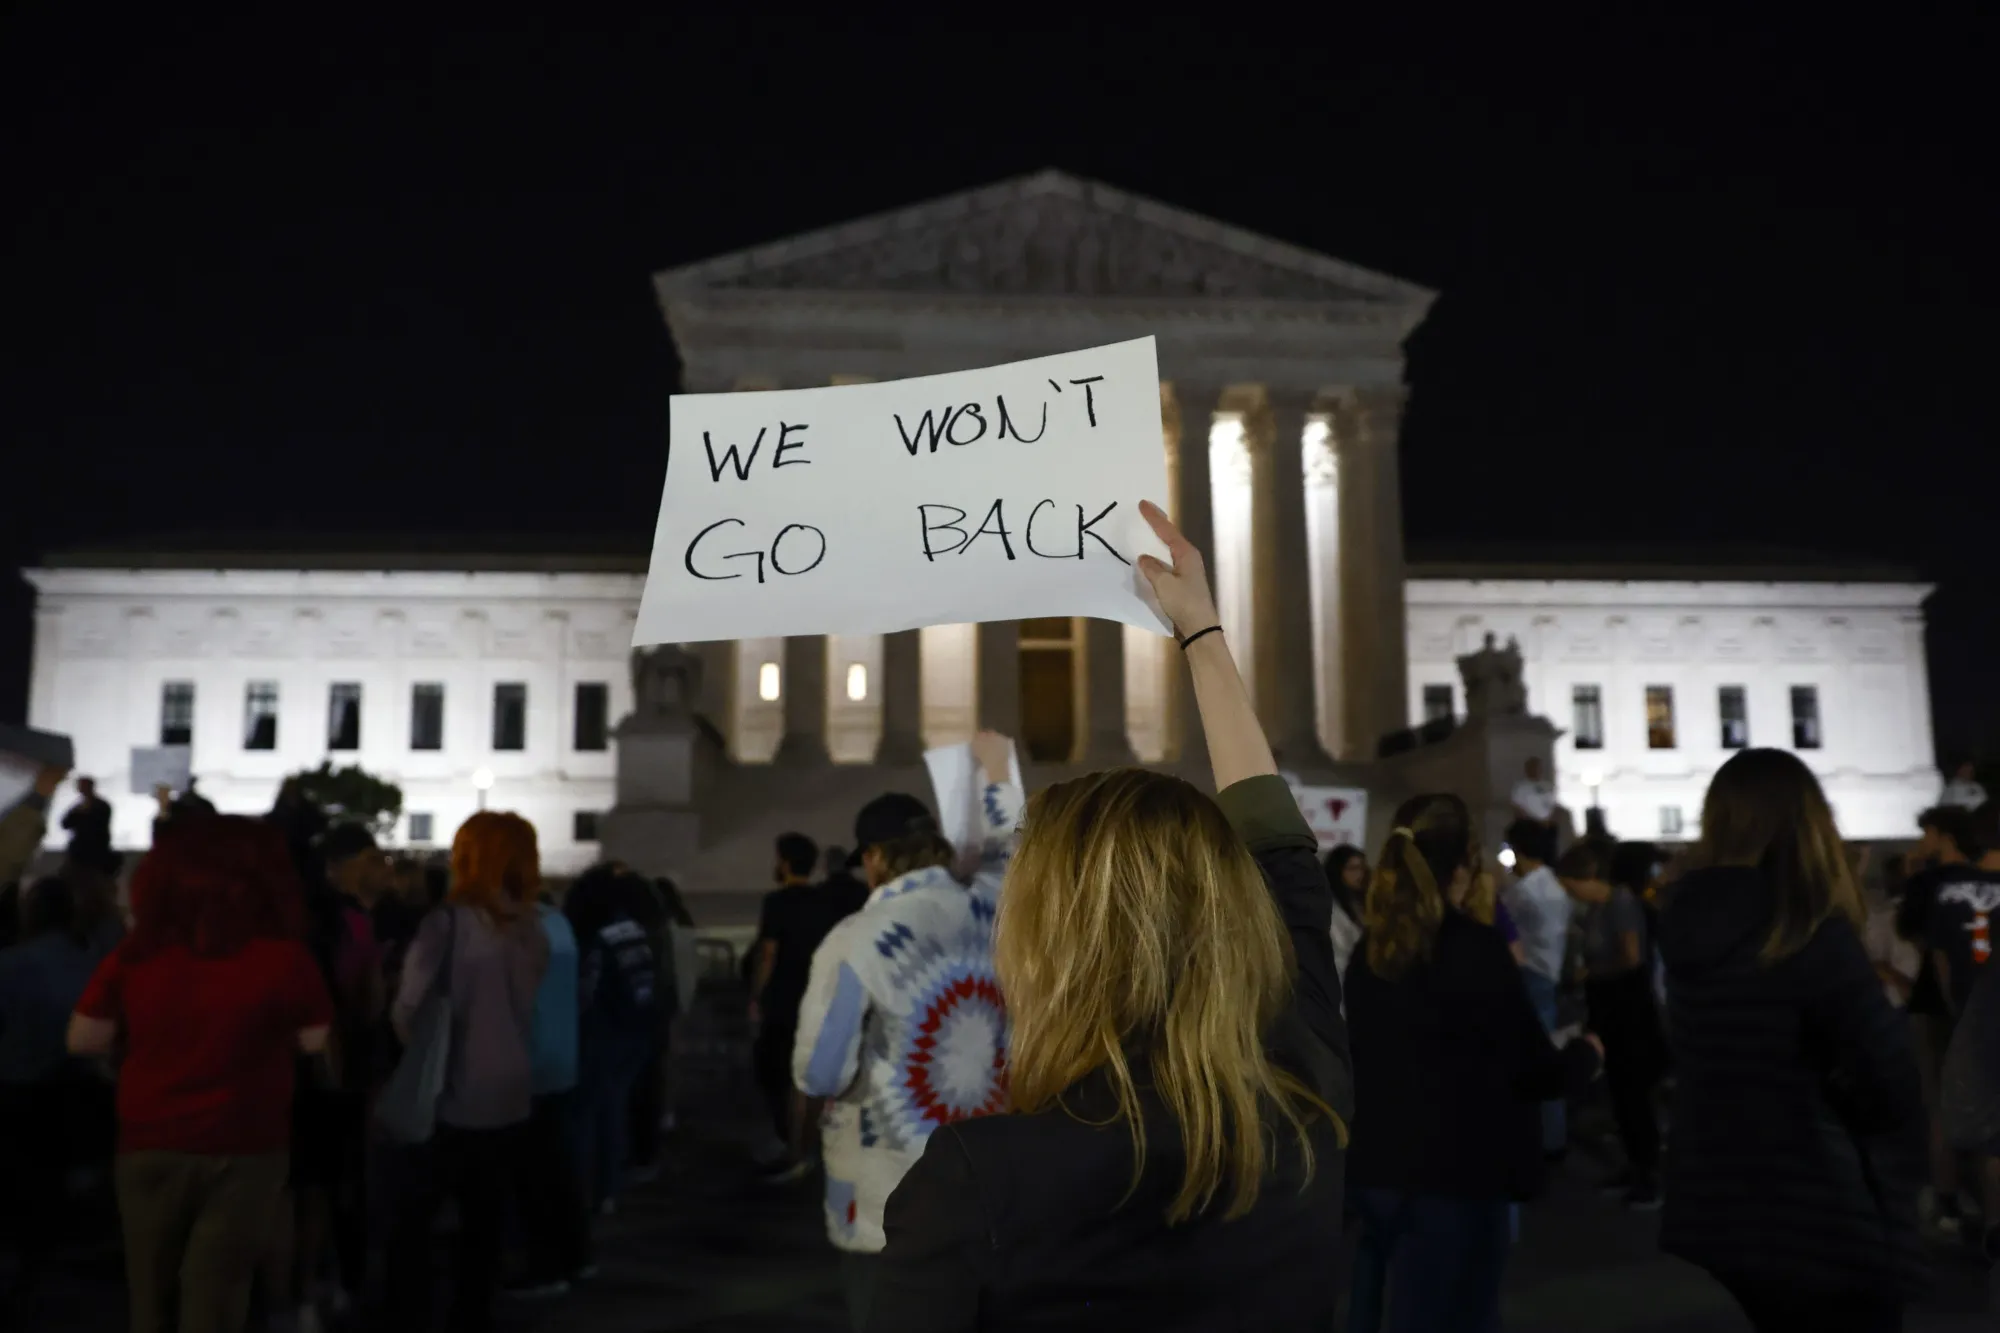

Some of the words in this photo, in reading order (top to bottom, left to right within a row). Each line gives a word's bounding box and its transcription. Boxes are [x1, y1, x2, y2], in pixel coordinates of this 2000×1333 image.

[703, 421, 811, 482] WE
[893, 375, 1104, 455] WON'T
[684, 518, 826, 583] GO
[917, 498, 1132, 566] BACK
